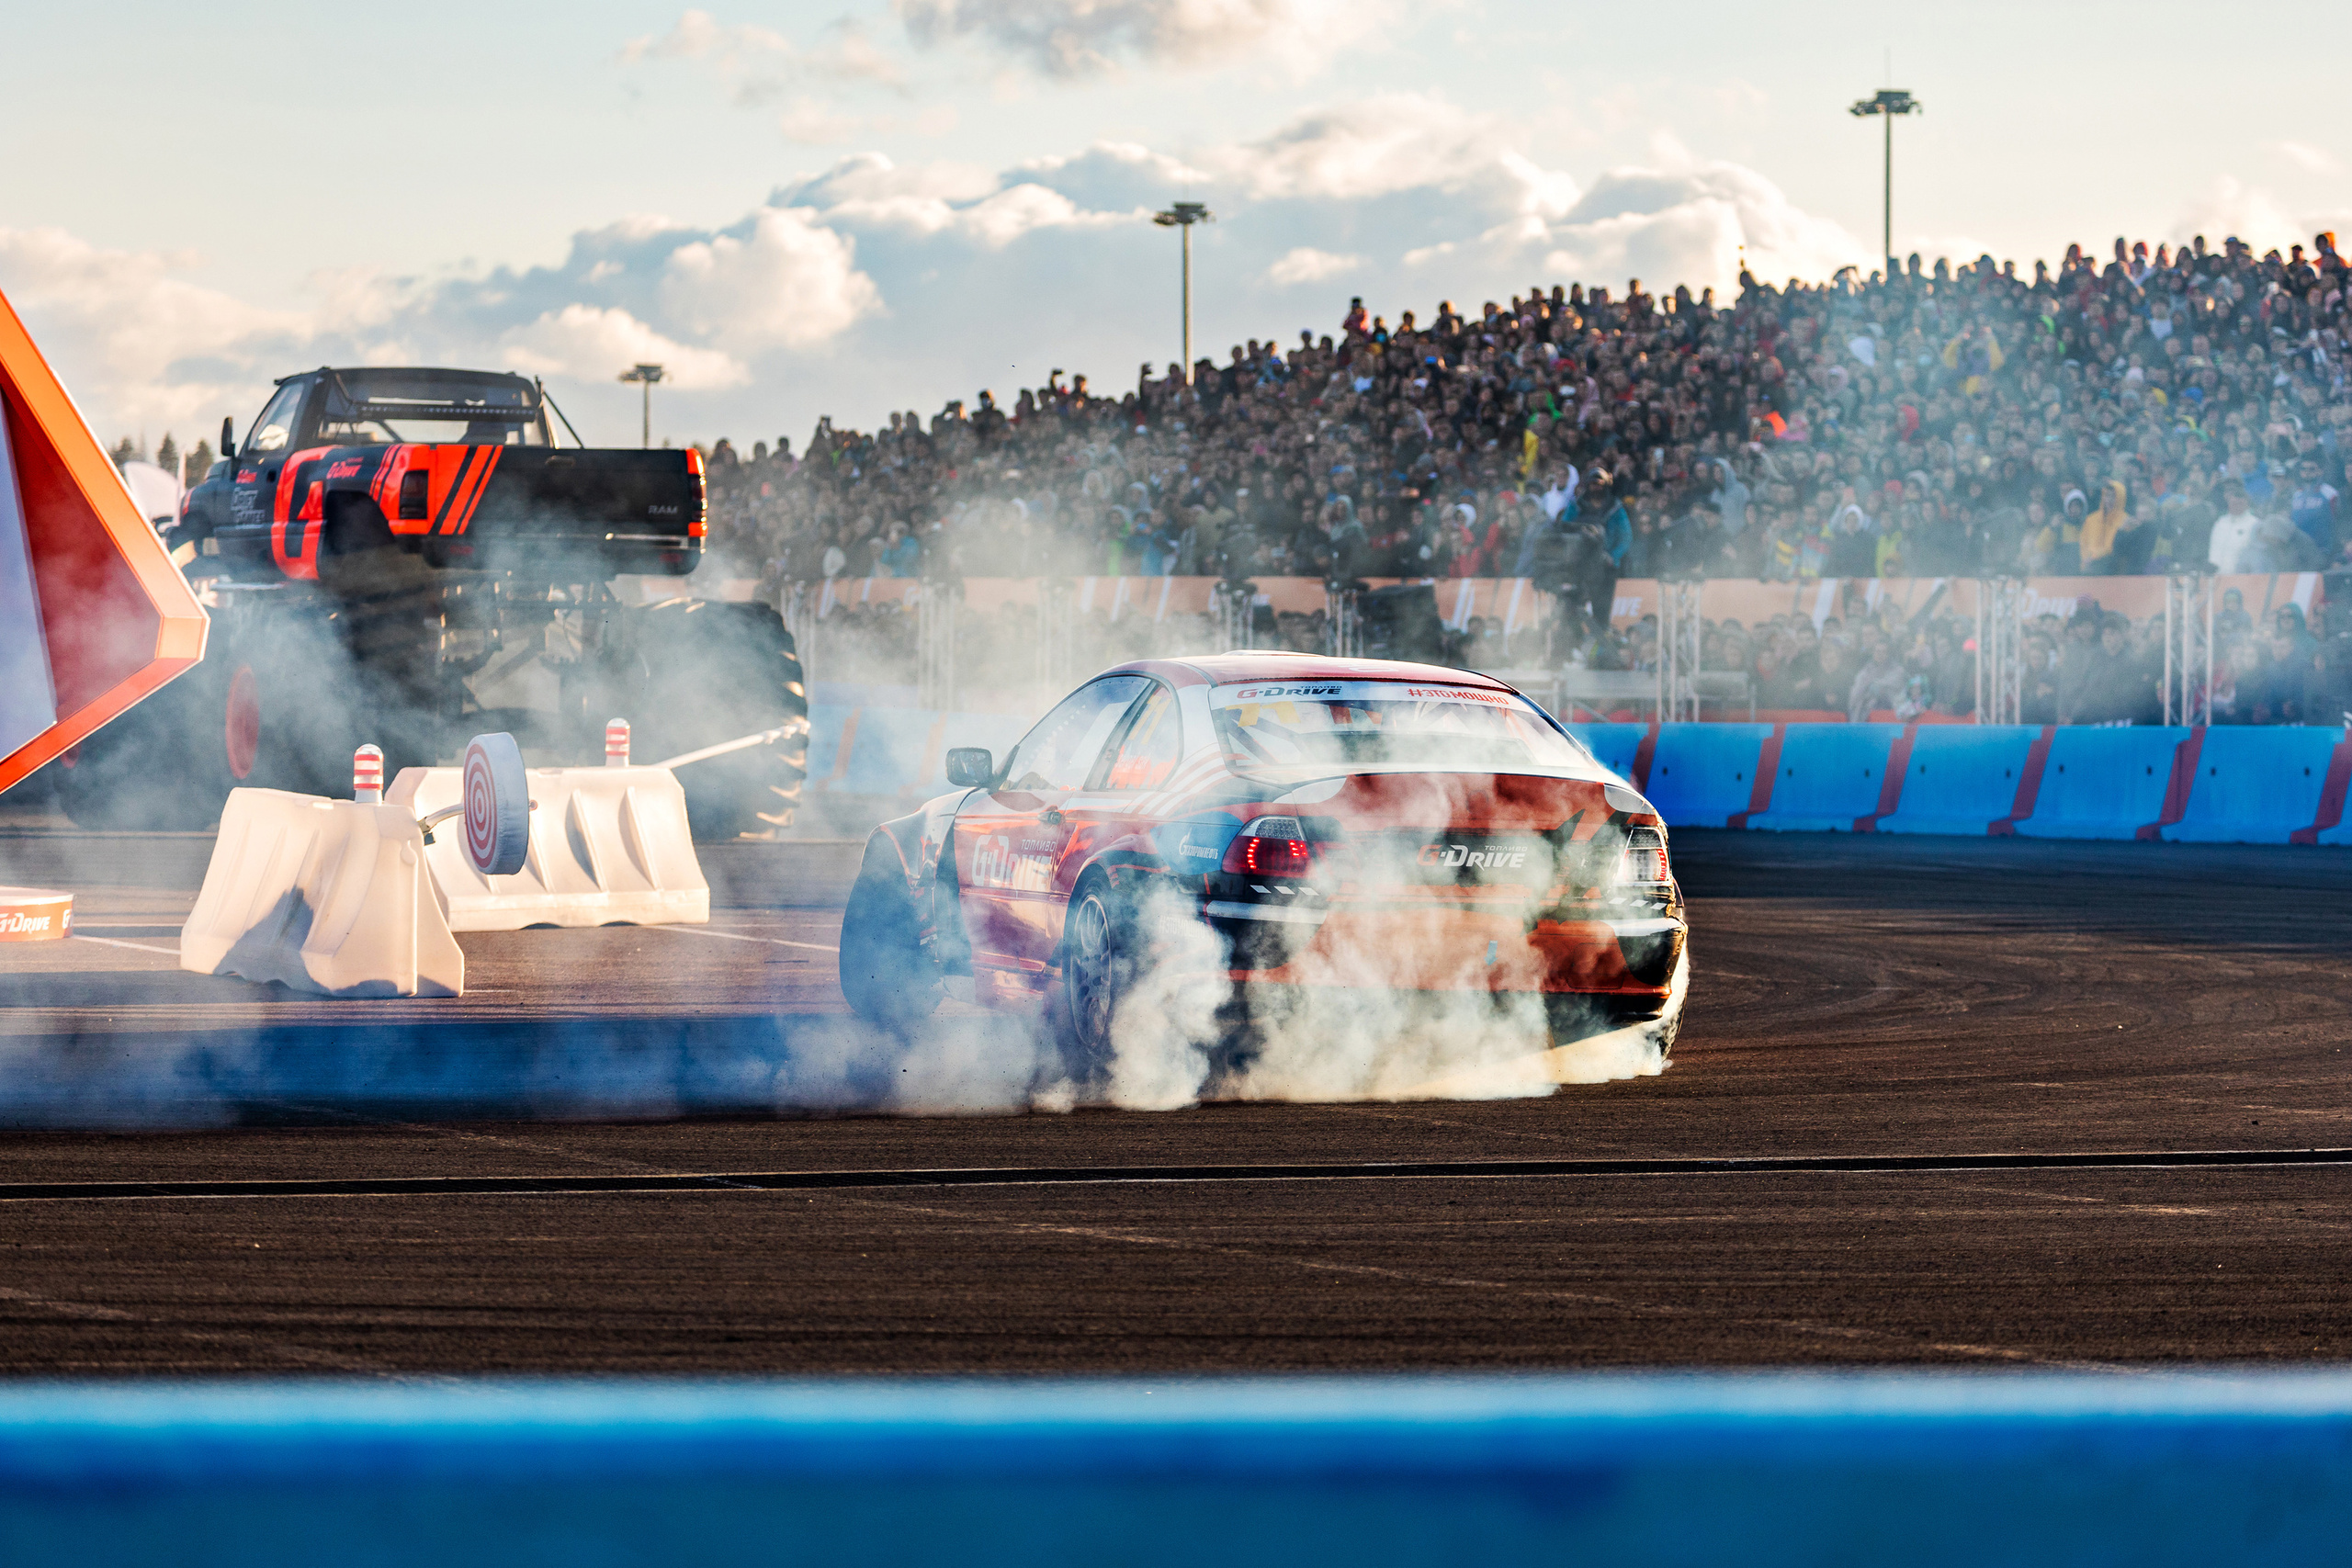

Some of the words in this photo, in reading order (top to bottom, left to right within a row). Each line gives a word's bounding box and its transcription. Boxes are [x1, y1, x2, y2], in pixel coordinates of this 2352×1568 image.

[648, 505, 678, 514] RAM
[1408, 688, 1509, 705] #ЭТОМОЩНО
[1021, 839, 1057, 852] ТОПЛИВО
[1417, 844, 1526, 872] G-DRIVE
